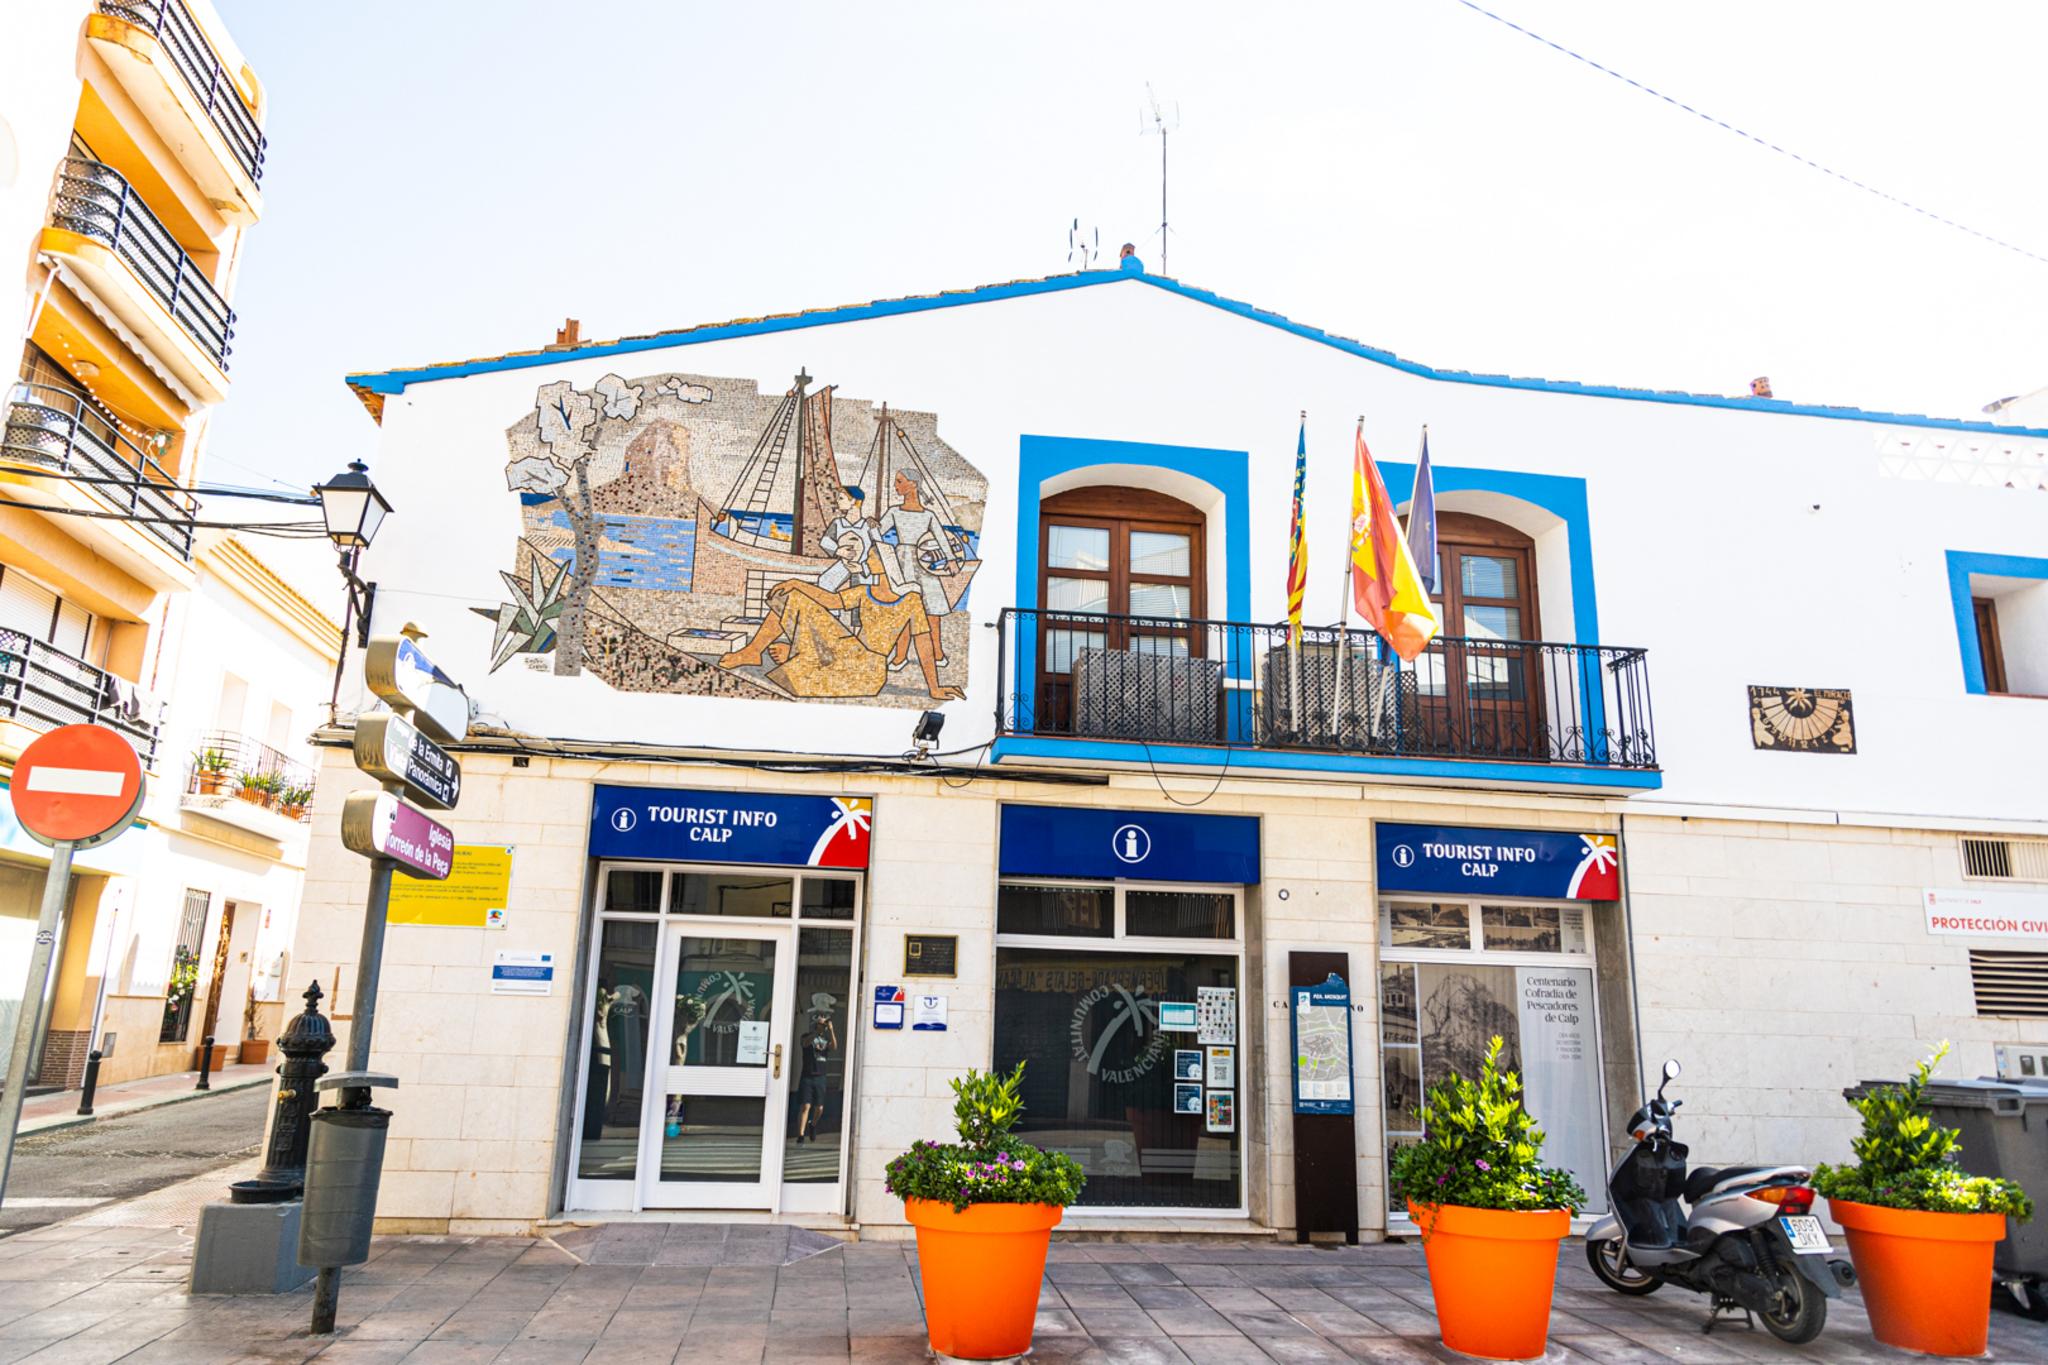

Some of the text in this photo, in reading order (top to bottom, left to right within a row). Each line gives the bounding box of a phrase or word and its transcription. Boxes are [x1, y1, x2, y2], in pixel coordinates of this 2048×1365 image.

[418, 739, 425, 757] la
[425, 744, 443, 771] Ermita
[408, 757, 442, 795] Panorámica
[648, 806, 777, 827] TOURIST INFO
[429, 824, 452, 851] Iglesia
[690, 827, 732, 843] CALP
[386, 830, 415, 858] Torreón
[414, 844, 424, 862] de
[425, 848, 432, 866] la
[1422, 843, 1536, 863] TOURIST INFO
[1461, 862, 1499, 877] CALP
[1931, 916, 2018, 931] PROTECCIÓN
[1526, 977, 1576, 987] Centenario
[1565, 989, 1578, 999] de
[1526, 1001, 1578, 1011] Pescadores
[1070, 985, 1109, 1061] COMUNITAT
[1544, 1012, 1579, 1026] de Calp
[1790, 1219, 1820, 1232] 6091
